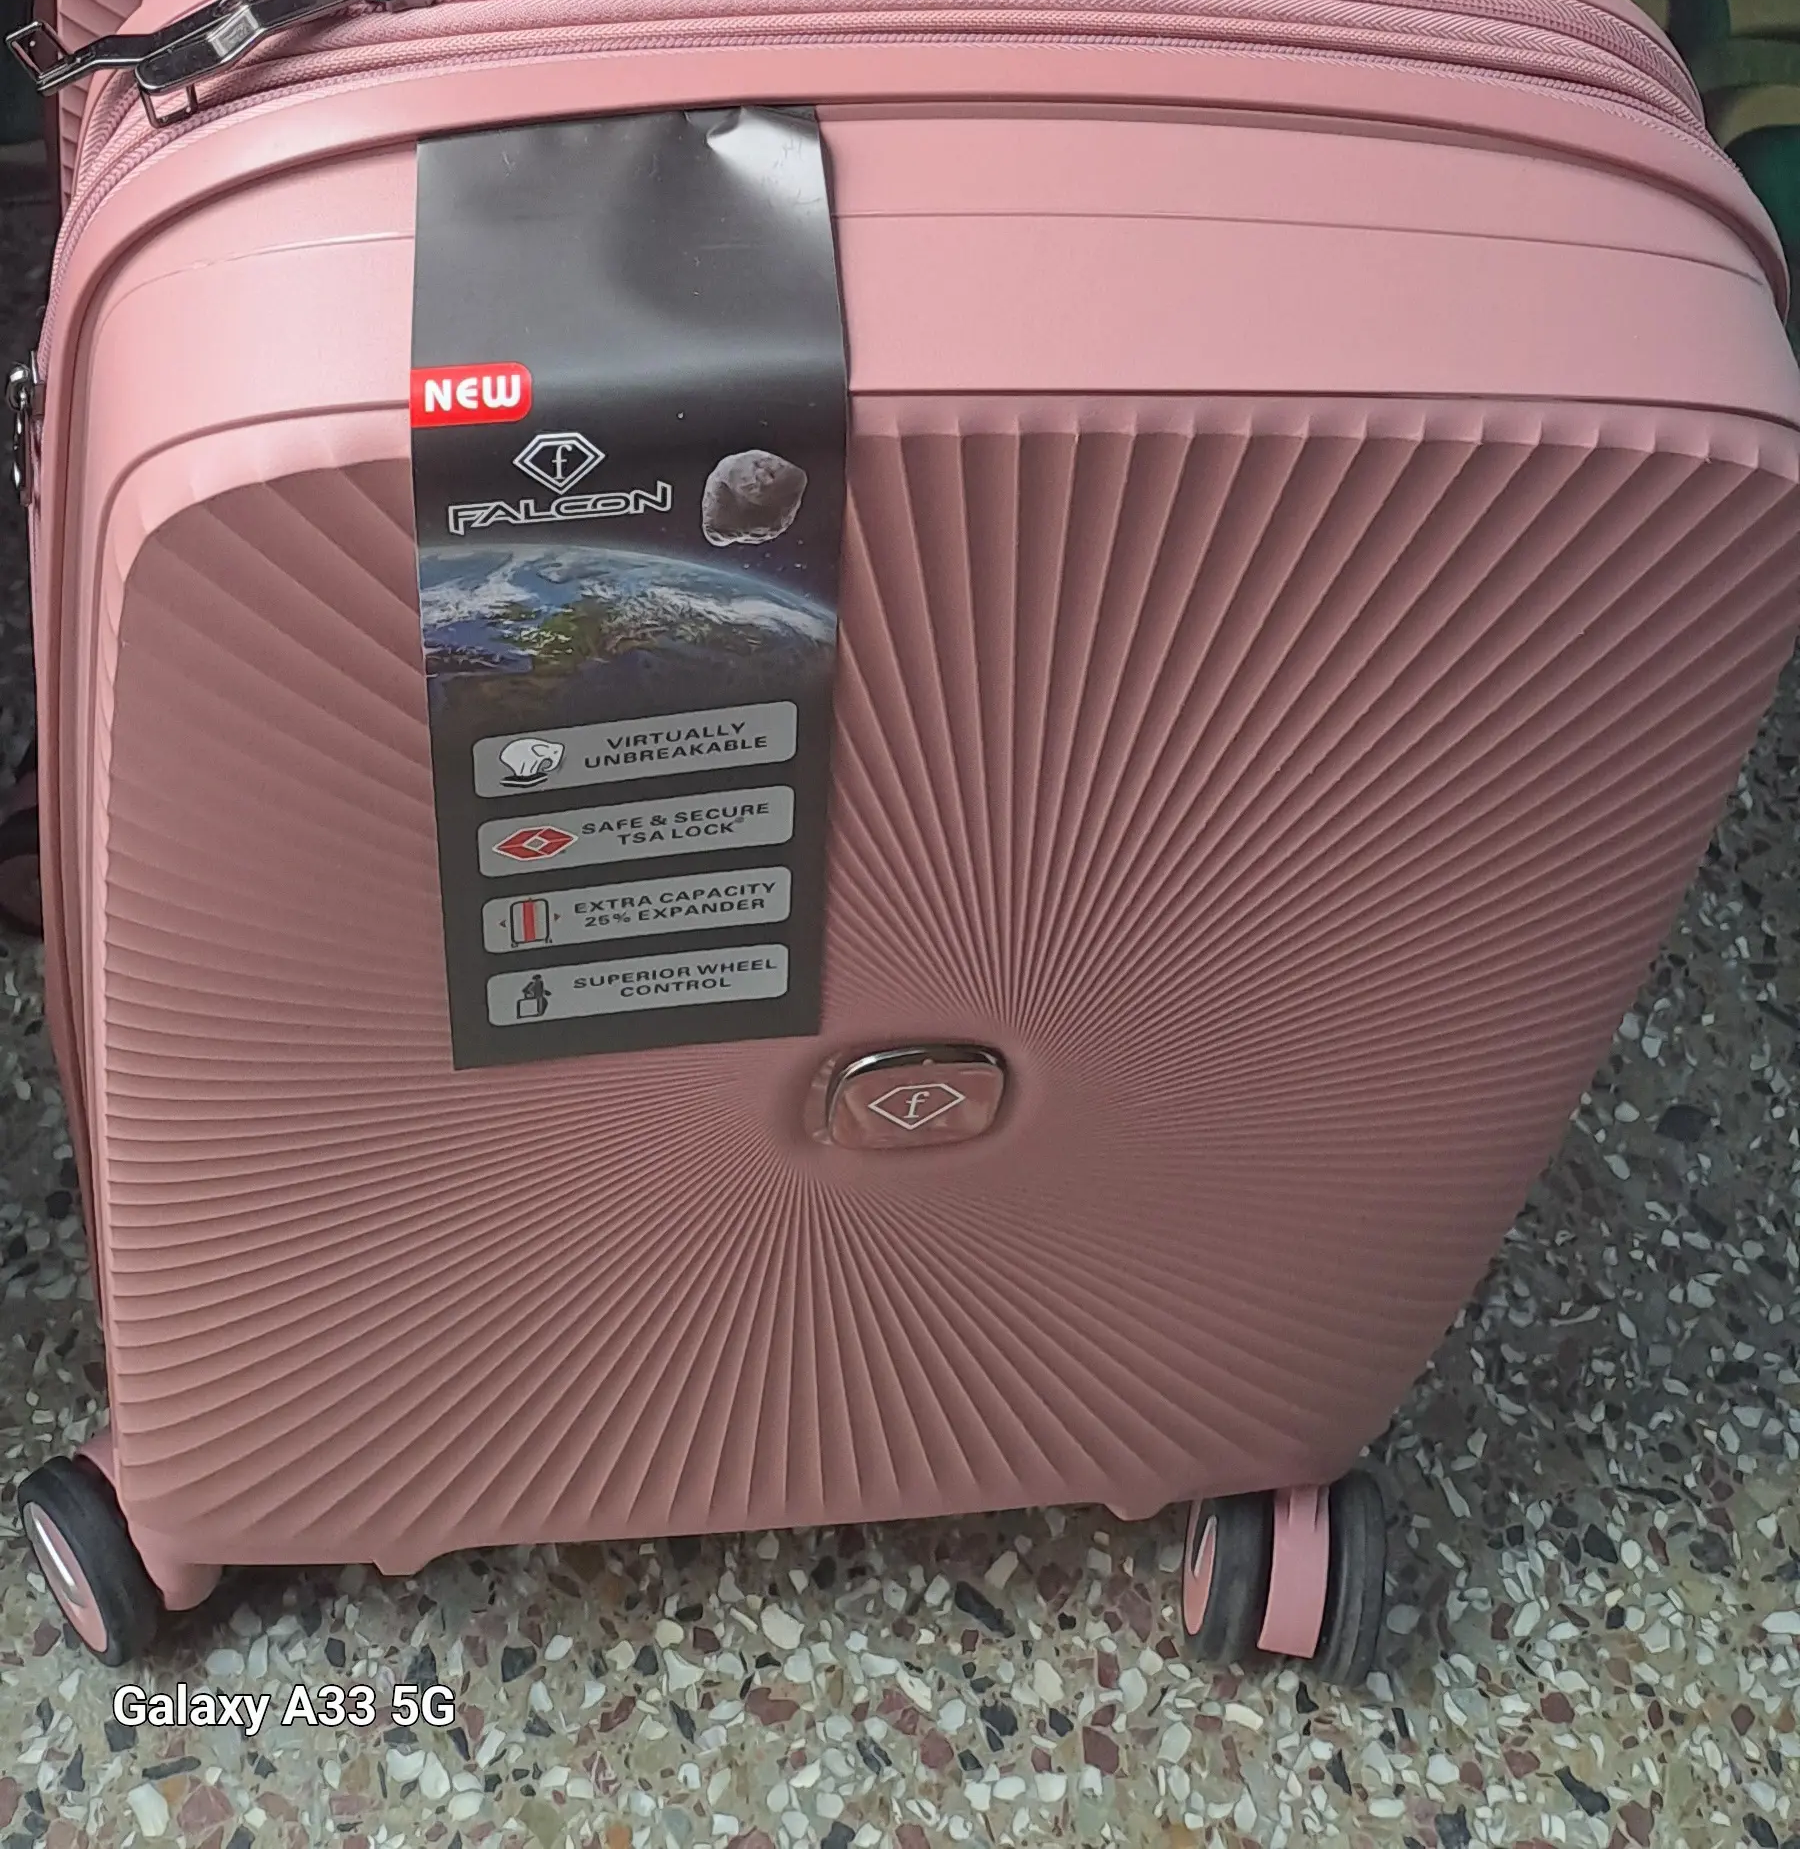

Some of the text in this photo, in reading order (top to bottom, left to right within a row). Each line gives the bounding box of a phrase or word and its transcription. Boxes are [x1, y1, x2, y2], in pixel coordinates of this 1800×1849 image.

[424, 374, 521, 412] NEW
[447, 480, 673, 536] FALCON
[606, 722, 746, 749] VIRTUALLY
[584, 735, 768, 769] UNBREAKABLE
[581, 802, 770, 835] SAFE & SECURE
[617, 829, 665, 845] TSA
[574, 881, 777, 915] EXTRA CAPACITY
[584, 897, 765, 928] 25% EXPANDER
[573, 958, 778, 989] SUPERIOR WHEEL
[620, 977, 731, 998] CONTROL
